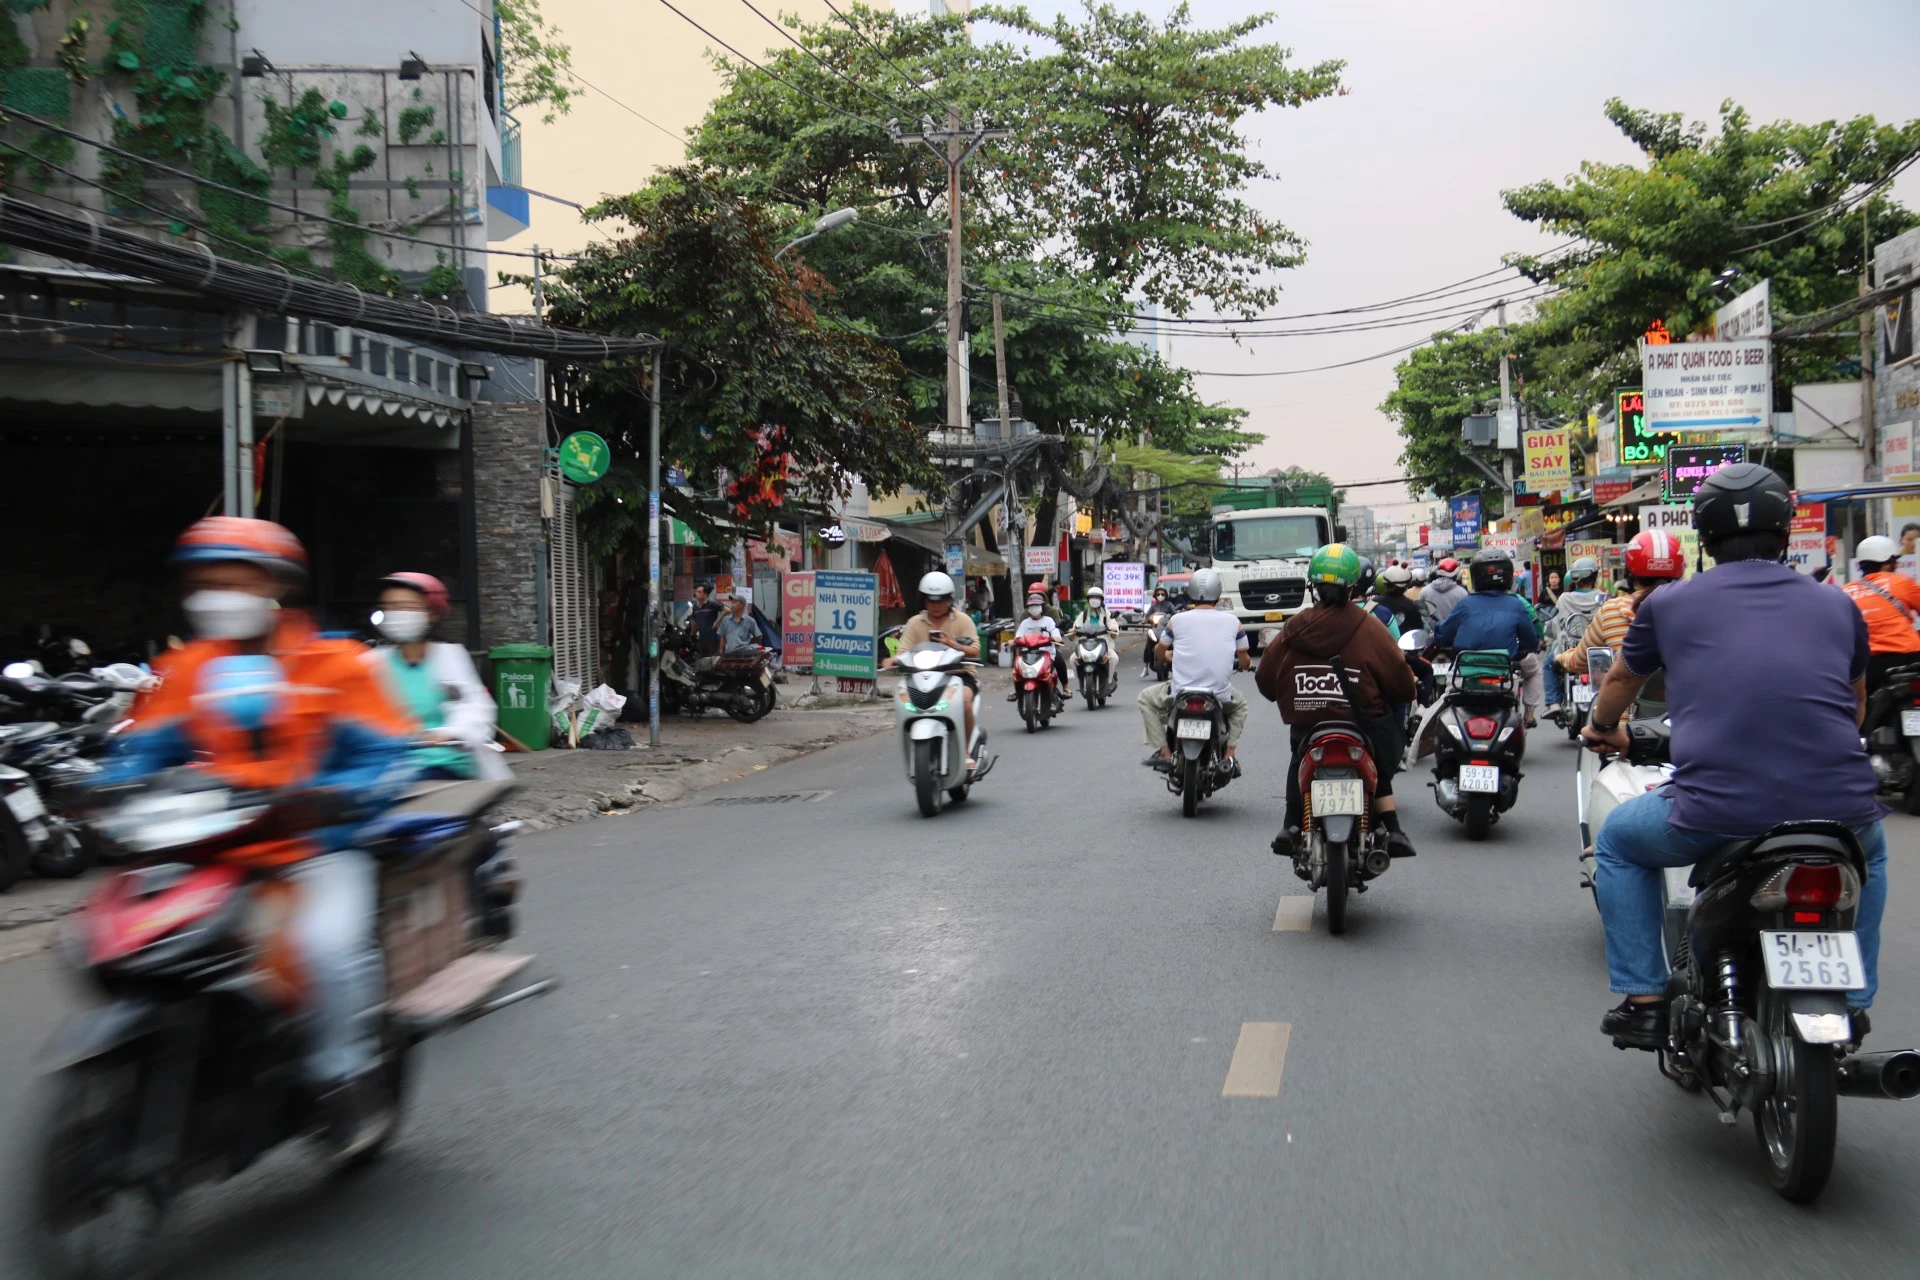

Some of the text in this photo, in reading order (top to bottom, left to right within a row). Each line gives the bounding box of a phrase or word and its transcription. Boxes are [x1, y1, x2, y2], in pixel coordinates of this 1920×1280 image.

[1648, 347, 1765, 370] A PHÁT QUÁN FOOD & BEER
[1648, 386, 1663, 398] LIÊN
[1665, 387, 1684, 397] HOAN
[1691, 386, 1708, 396] SINH
[1709, 384, 1728, 397] NHẬT
[1734, 383, 1749, 395] HỌP
[1751, 382, 1766, 394] MẶT
[1527, 432, 1565, 450] GIẶT
[1625, 441, 1648, 460] BÒ
[1530, 450, 1564, 469] SẤY
[1648, 506, 1695, 527] A PHÁT
[683, 530, 695, 545] 16
[1106, 571, 1121, 580] ỐC
[1241, 570, 1304, 579] HYUNDAI
[819, 591, 871, 606] NHÀ THUỐC
[832, 609, 857, 630] 16
[785, 633, 805, 643] THEO
[816, 635, 872, 653] Salonpas
[816, 659, 870, 673] Hisamitsu
[1465, 767, 1493, 779] 59-X3
[1319, 782, 1355, 796] 33-N4
[1462, 778, 1495, 790] 420.61
[1319, 798, 1356, 813] 7971
[1775, 934, 1843, 958] 54-U1
[1780, 960, 1851, 985] 2563
